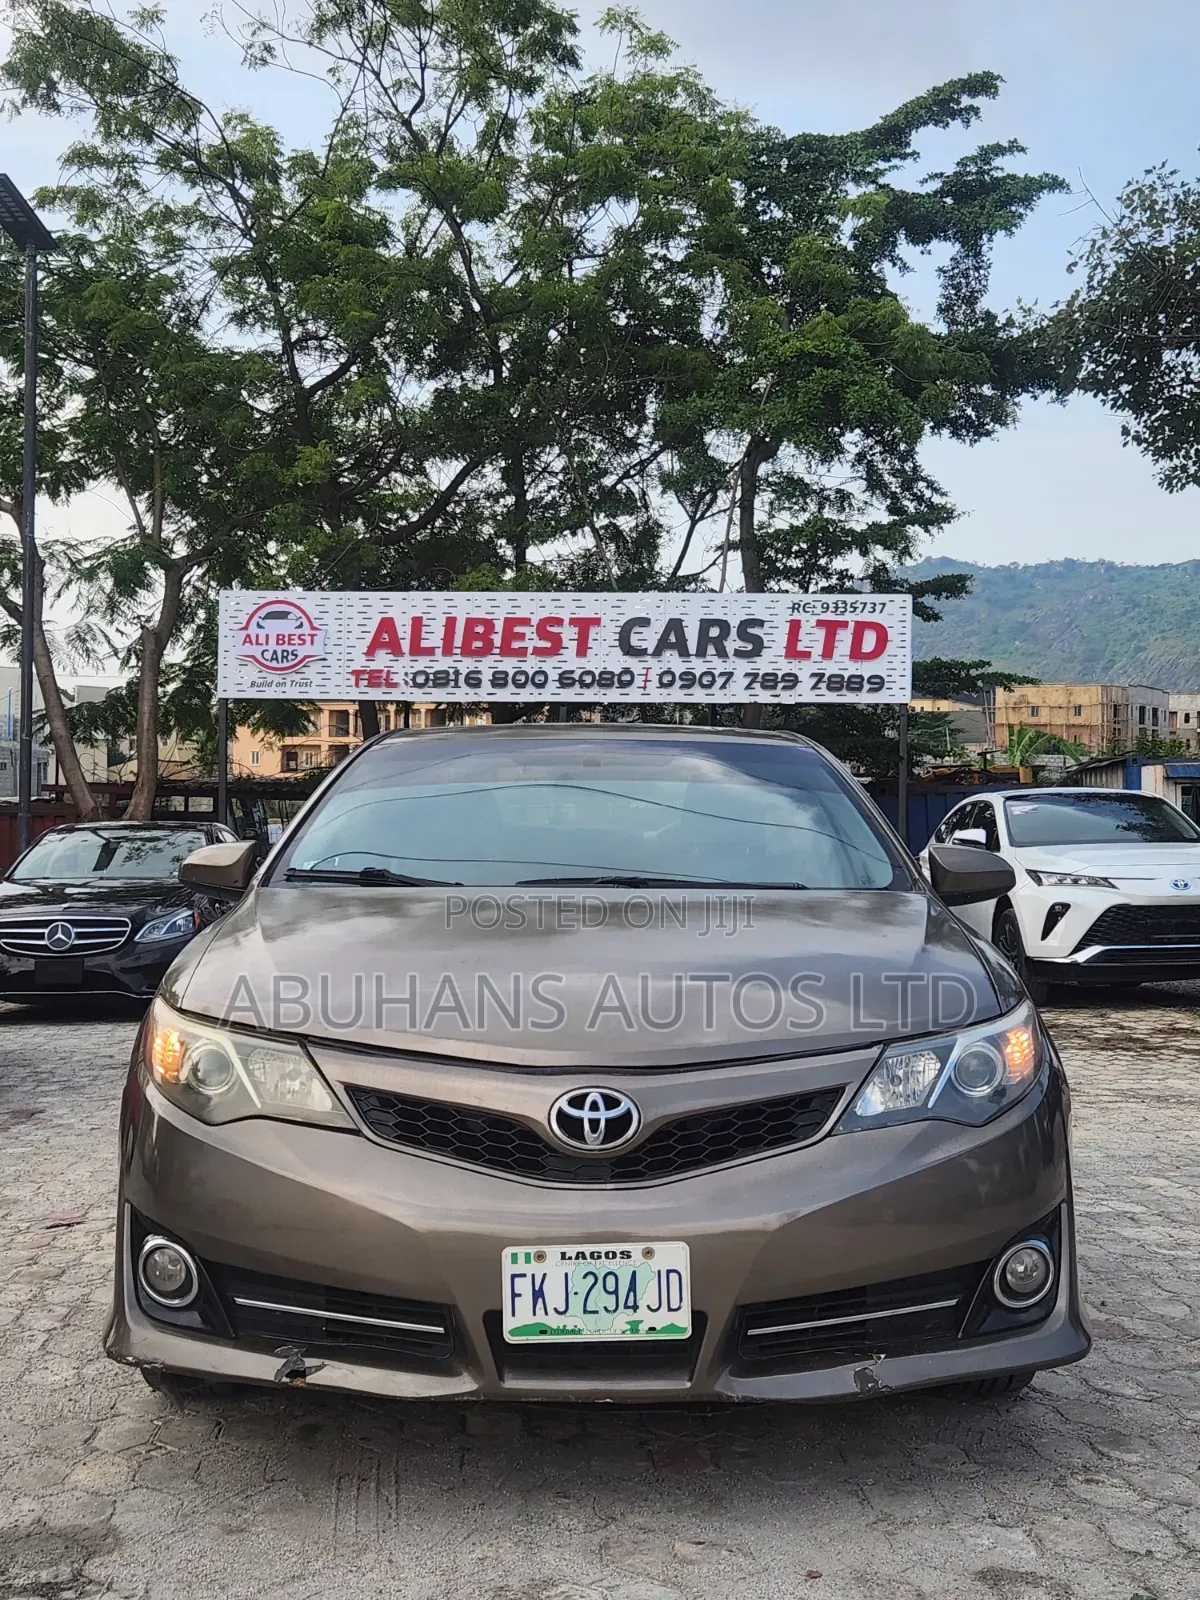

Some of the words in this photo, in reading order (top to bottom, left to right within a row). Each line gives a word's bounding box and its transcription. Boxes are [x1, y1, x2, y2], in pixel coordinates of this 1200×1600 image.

[820, 602, 887, 614] 9335737
[242, 633, 270, 647] ALI
[275, 633, 318, 647] BEST
[364, 616, 601, 657] ALIBEST
[617, 617, 765, 659] CARS
[784, 619, 889, 661] LTD
[261, 649, 299, 664] CARS
[249, 680, 274, 688] Build
[290, 680, 313, 688] Trust
[491, 669, 549, 690] 800
[557, 669, 635, 689] 6080
[658, 670, 734, 690] 0907
[743, 672, 800, 692] 789
[809, 672, 887, 692] 7889
[560, 1250, 632, 1261] LAGOS
